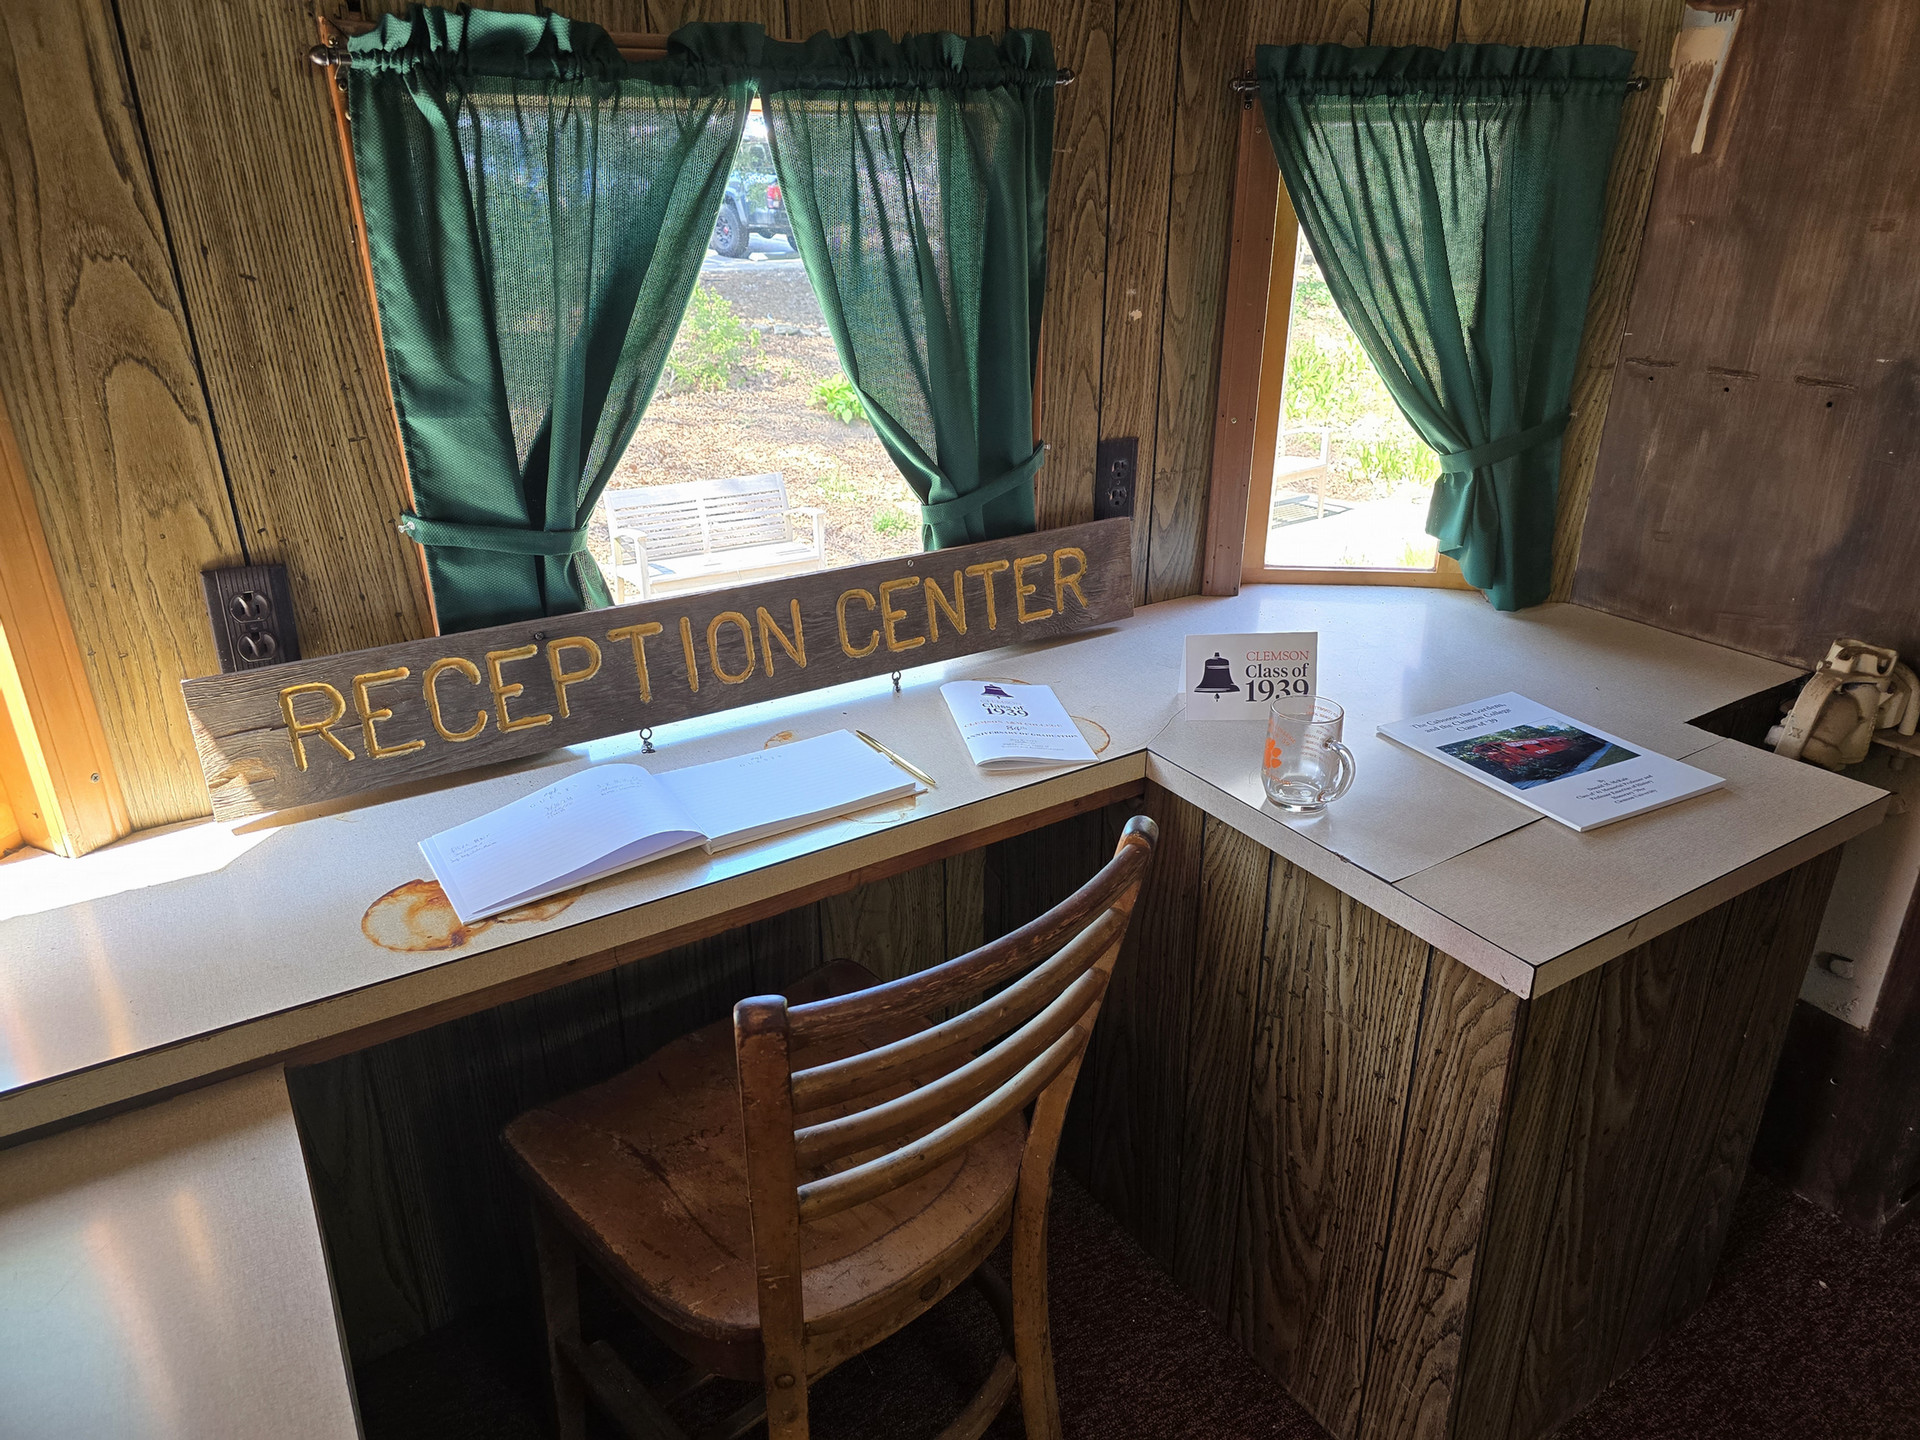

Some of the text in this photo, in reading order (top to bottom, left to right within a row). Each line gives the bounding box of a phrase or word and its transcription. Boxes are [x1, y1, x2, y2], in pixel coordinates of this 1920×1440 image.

[279, 547, 1089, 772] RECEPTION CENTER
[1246, 650, 1309, 662] CLEMSON
[1245, 663, 1310, 678] Class of
[1245, 679, 1310, 703] 1939
[986, 707, 1029, 718] 1939
